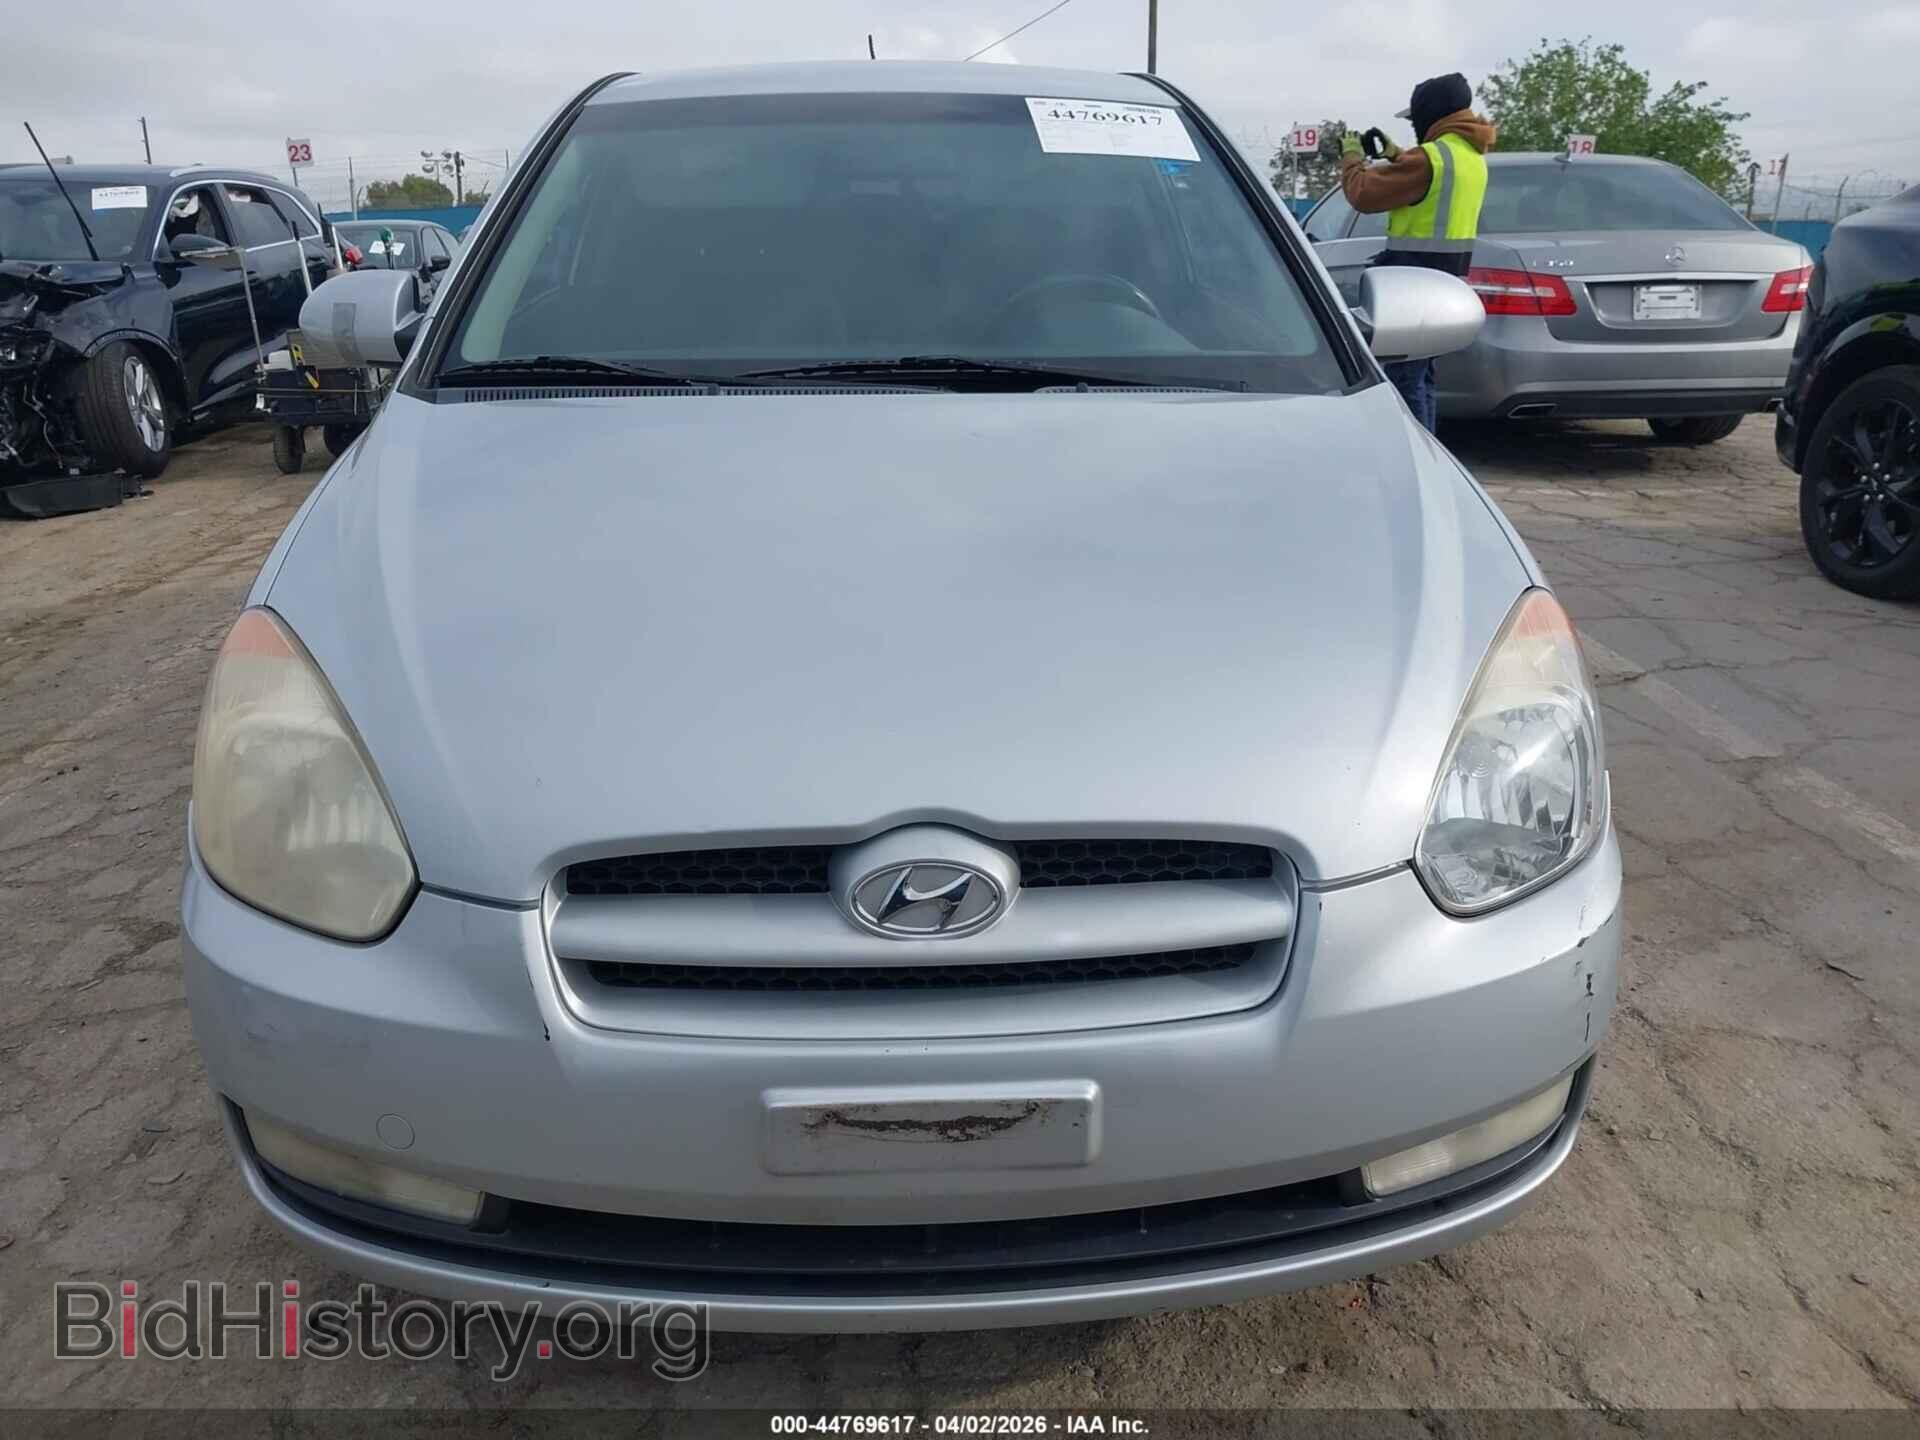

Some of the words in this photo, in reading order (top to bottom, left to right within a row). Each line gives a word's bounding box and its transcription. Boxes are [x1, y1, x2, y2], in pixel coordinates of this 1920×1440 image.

[1047, 109, 1163, 126] 44769617
[1294, 129, 1316, 147] 19
[288, 144, 312, 162] 23
